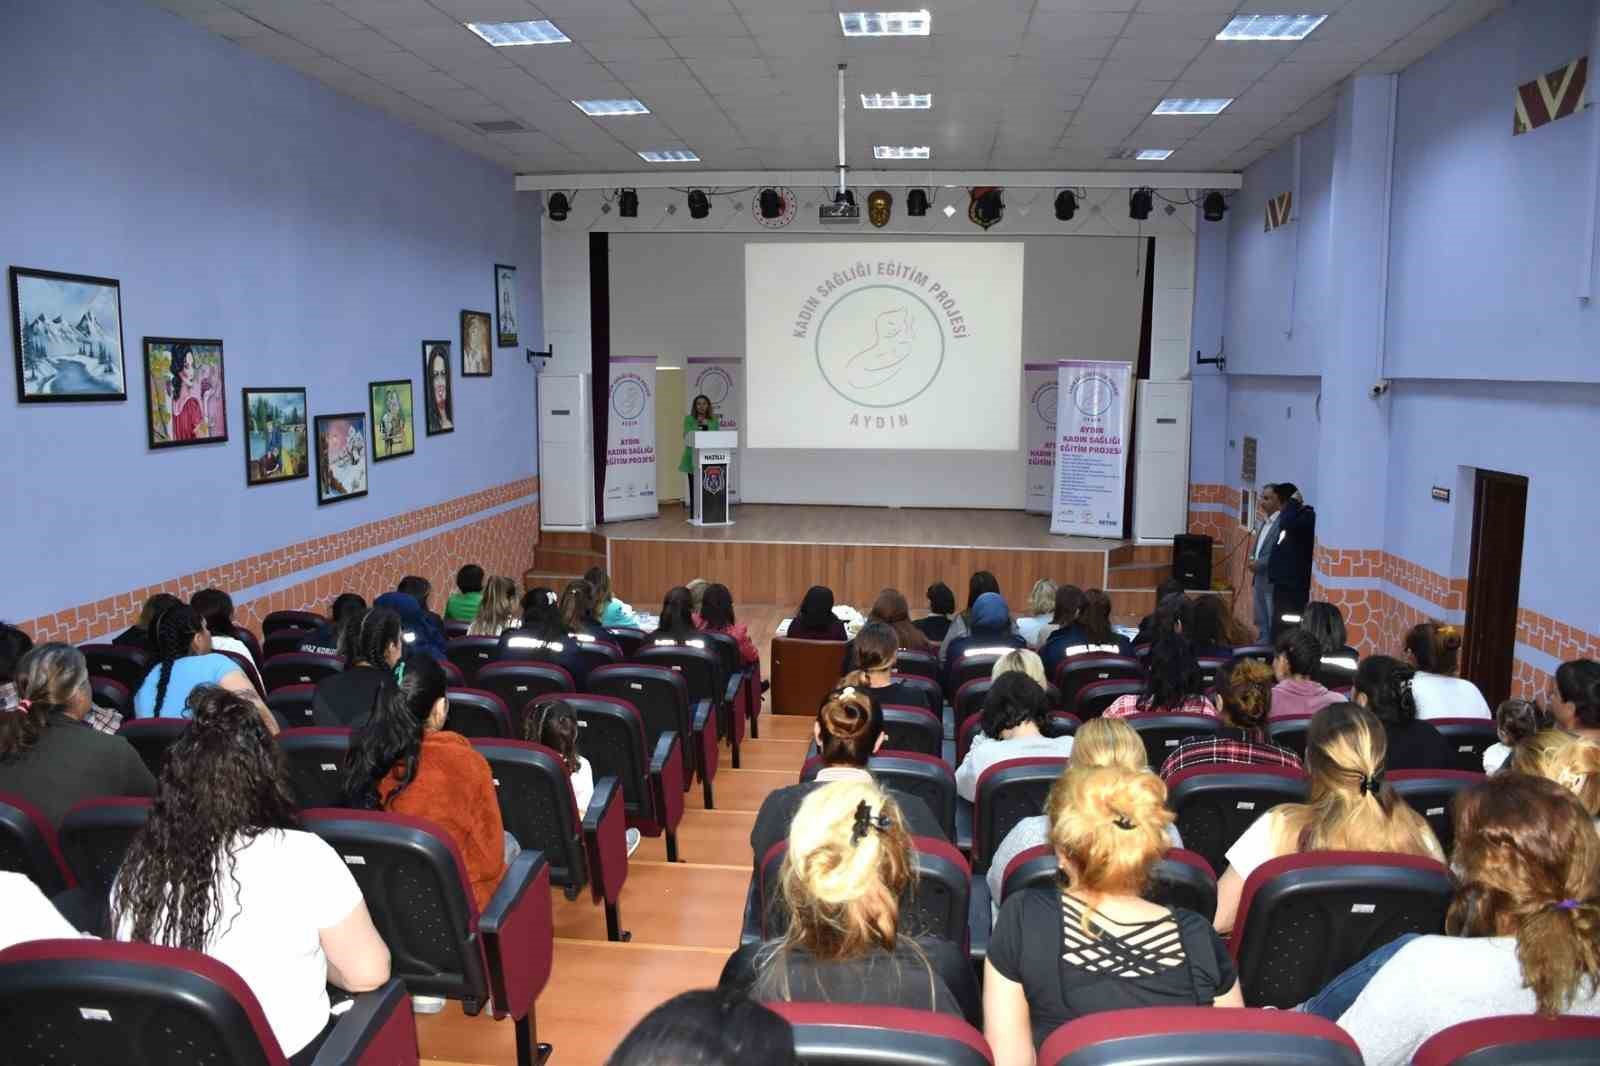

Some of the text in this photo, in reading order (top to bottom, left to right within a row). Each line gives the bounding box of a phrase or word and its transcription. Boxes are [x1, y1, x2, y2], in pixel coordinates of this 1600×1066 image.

[792, 259, 971, 339] KADIN SAĞLIĞI EĞİTİM PROJESİ
[850, 413, 909, 429] AYDIN
[1080, 426, 1104, 434] AYDIN
